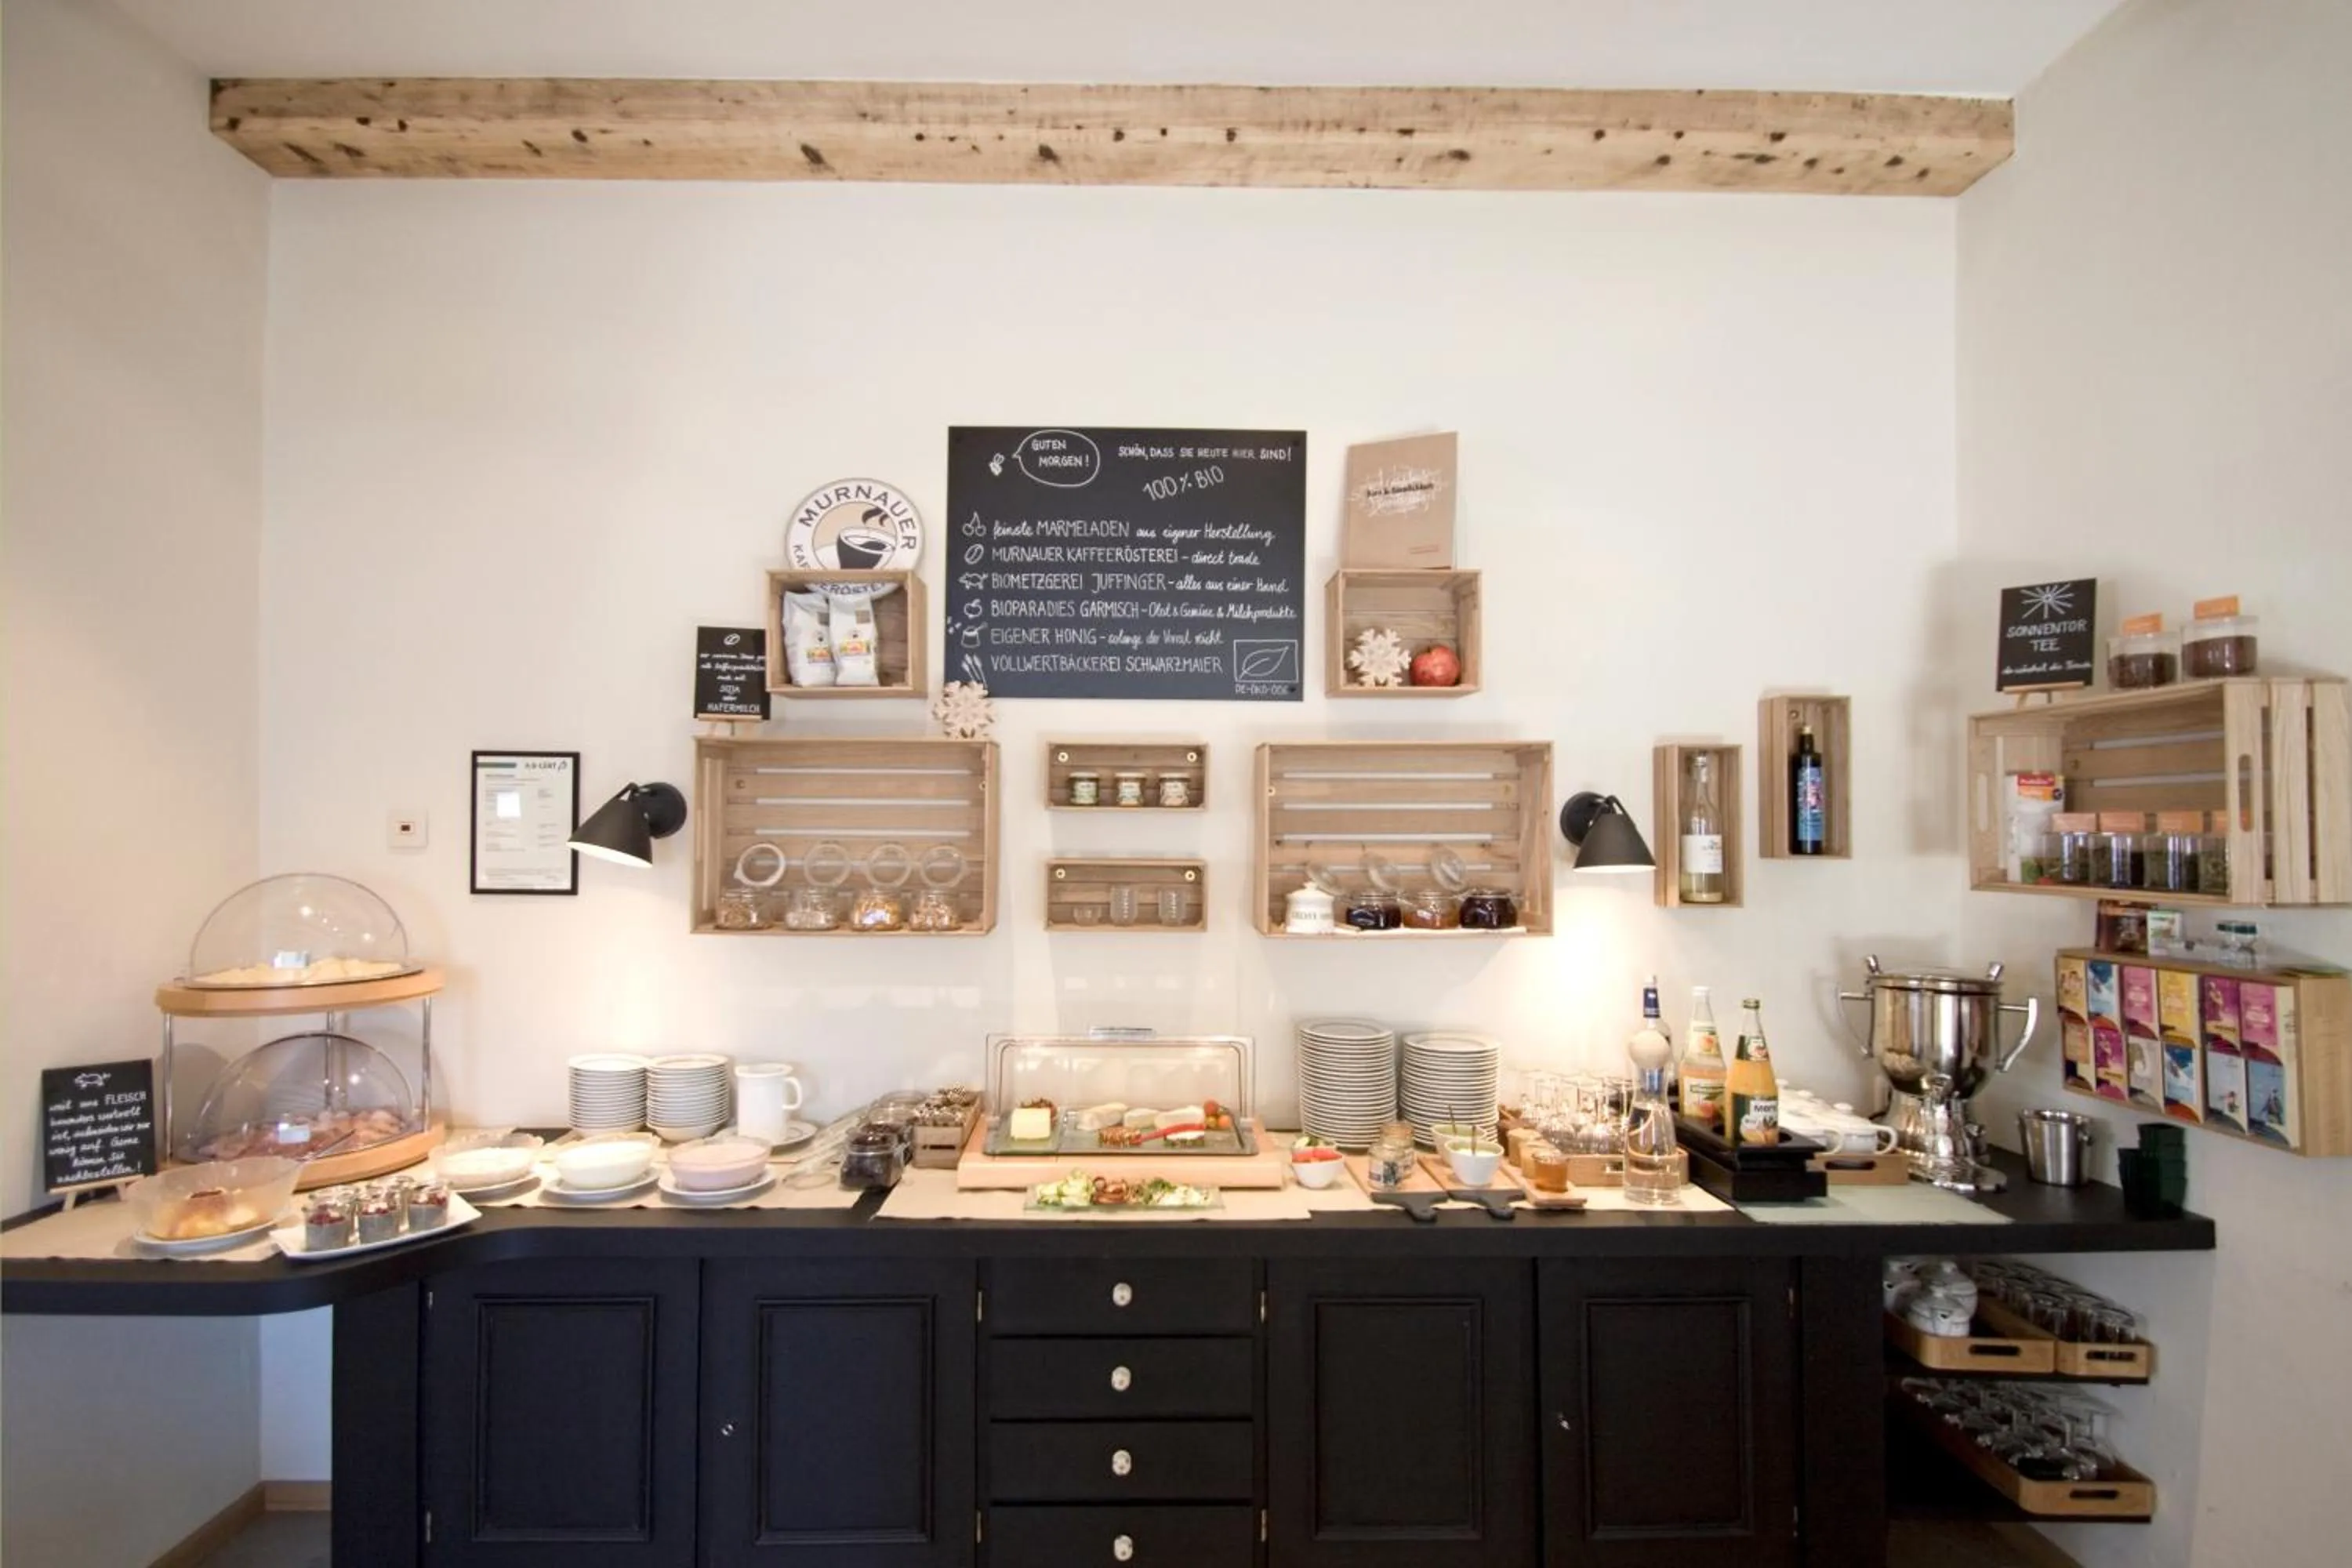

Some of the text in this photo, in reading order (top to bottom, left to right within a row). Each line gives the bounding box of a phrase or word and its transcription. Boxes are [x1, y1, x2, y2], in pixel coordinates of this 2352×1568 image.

[1031, 439, 1067, 451] GUTEN
[1150, 447, 1174, 458] DASS
[1180, 447, 1194, 458] SIE
[1198, 448, 1229, 459] HEUTE
[1194, 465, 1224, 488] BIO
[798, 485, 916, 550] MURNAUER
[1036, 520, 1130, 538] MARMELADEN
[1137, 528, 1156, 539] aus
[1163, 524, 1202, 544] eigener
[1203, 522, 1276, 547] Herstellung
[992, 545, 1064, 562] MURNAUER
[1065, 544, 1178, 564] KAFFEERÖSTEREI
[1191, 550, 1226, 564] direct
[1228, 550, 1261, 565] trade
[992, 573, 1083, 590] BIOMETZGEREI
[1091, 572, 1167, 593] JUFFINGER
[1176, 574, 1203, 591] alles
[1205, 582, 1225, 591] aus
[1226, 578, 1255, 592] einer
[1256, 577, 1290, 593] Hand
[990, 599, 1075, 618] BIOPARADIES
[1080, 599, 1140, 619] GARMISCH
[1179, 601, 1215, 618] Gemüse
[990, 628, 1051, 645] EIGENER
[1055, 628, 1098, 645] HONIG
[1107, 629, 1144, 650] solange
[1145, 630, 1160, 645] der
[2005, 619, 2088, 638] SONNENTOR
[2029, 637, 2061, 652] TEE
[990, 653, 1224, 674] VOLLWERTBÄCKEREI SCHWARZMAIER
[104, 1091, 147, 1105] FLEISCH
